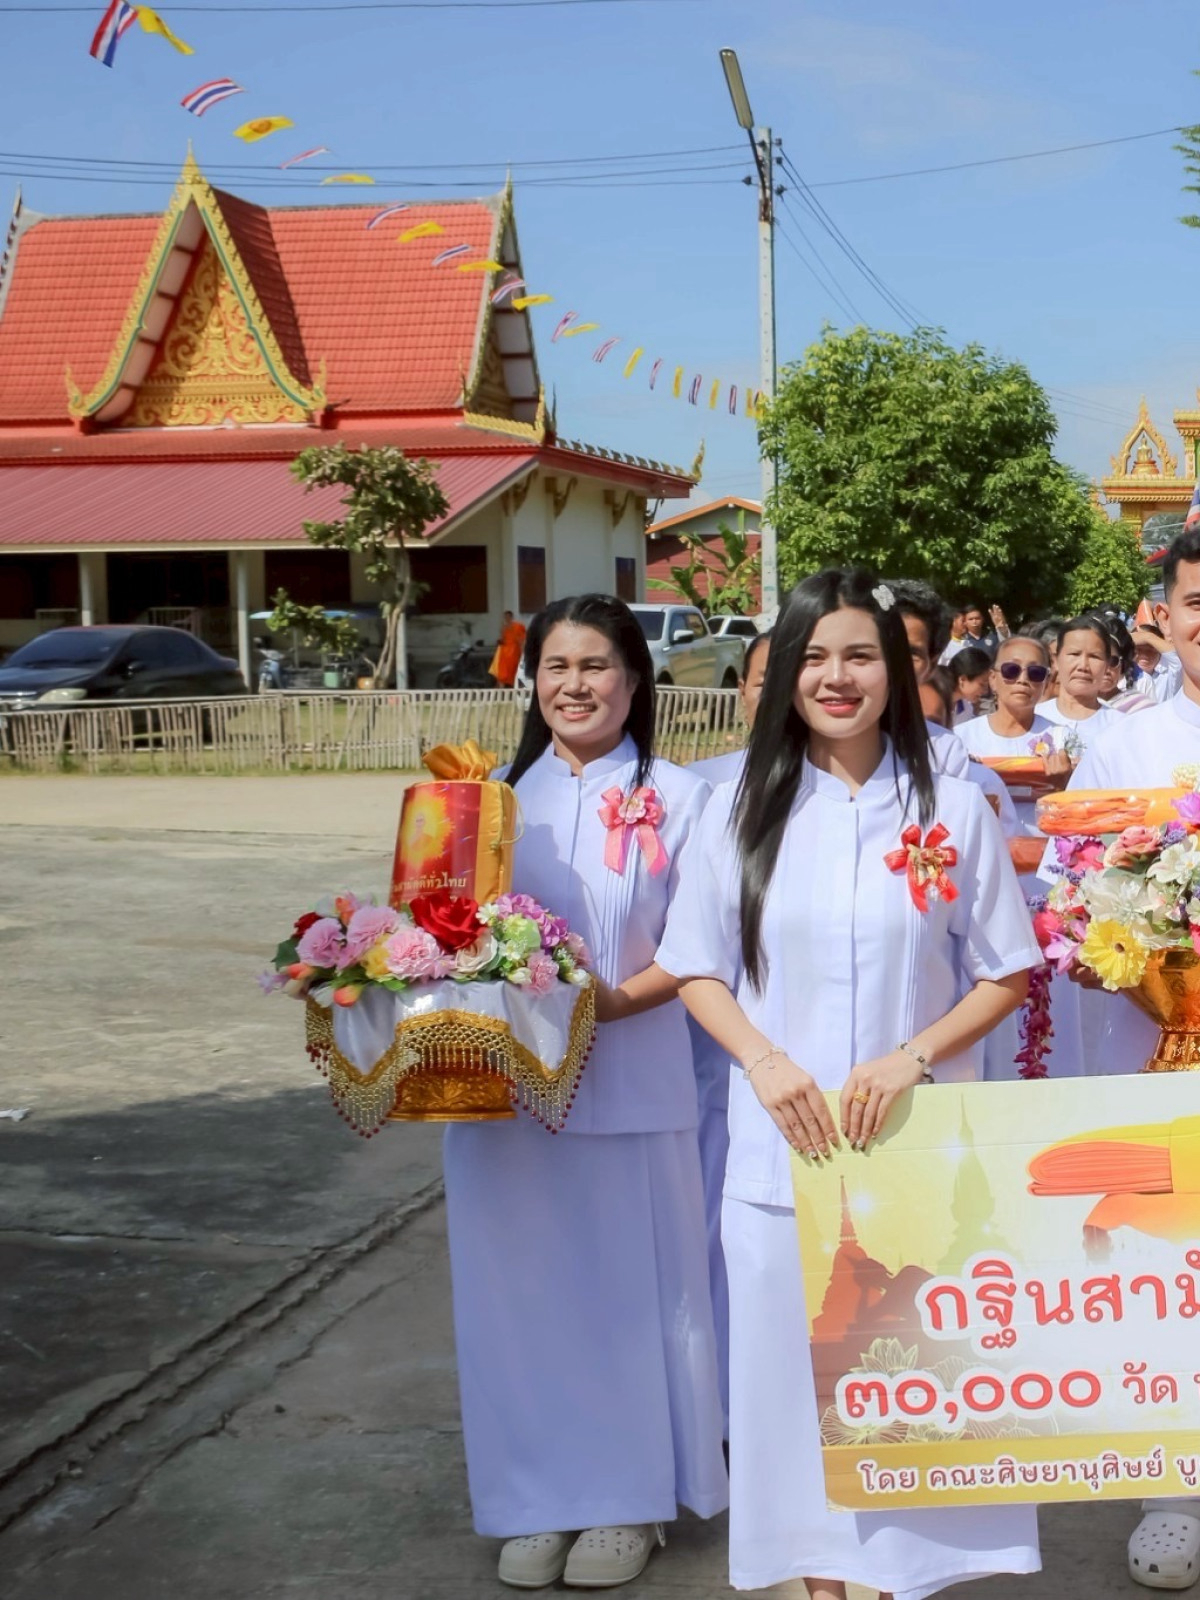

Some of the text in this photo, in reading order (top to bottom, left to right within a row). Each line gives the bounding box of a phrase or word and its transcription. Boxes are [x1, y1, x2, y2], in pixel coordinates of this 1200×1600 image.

[844, 1369, 1102, 1423] ๓๐,๐๐๐
[1122, 1360, 1179, 1404] วัด
[861, 1464, 916, 1491] โดย
[930, 1448, 1164, 1490] คณะศิษยานุศิษย์
